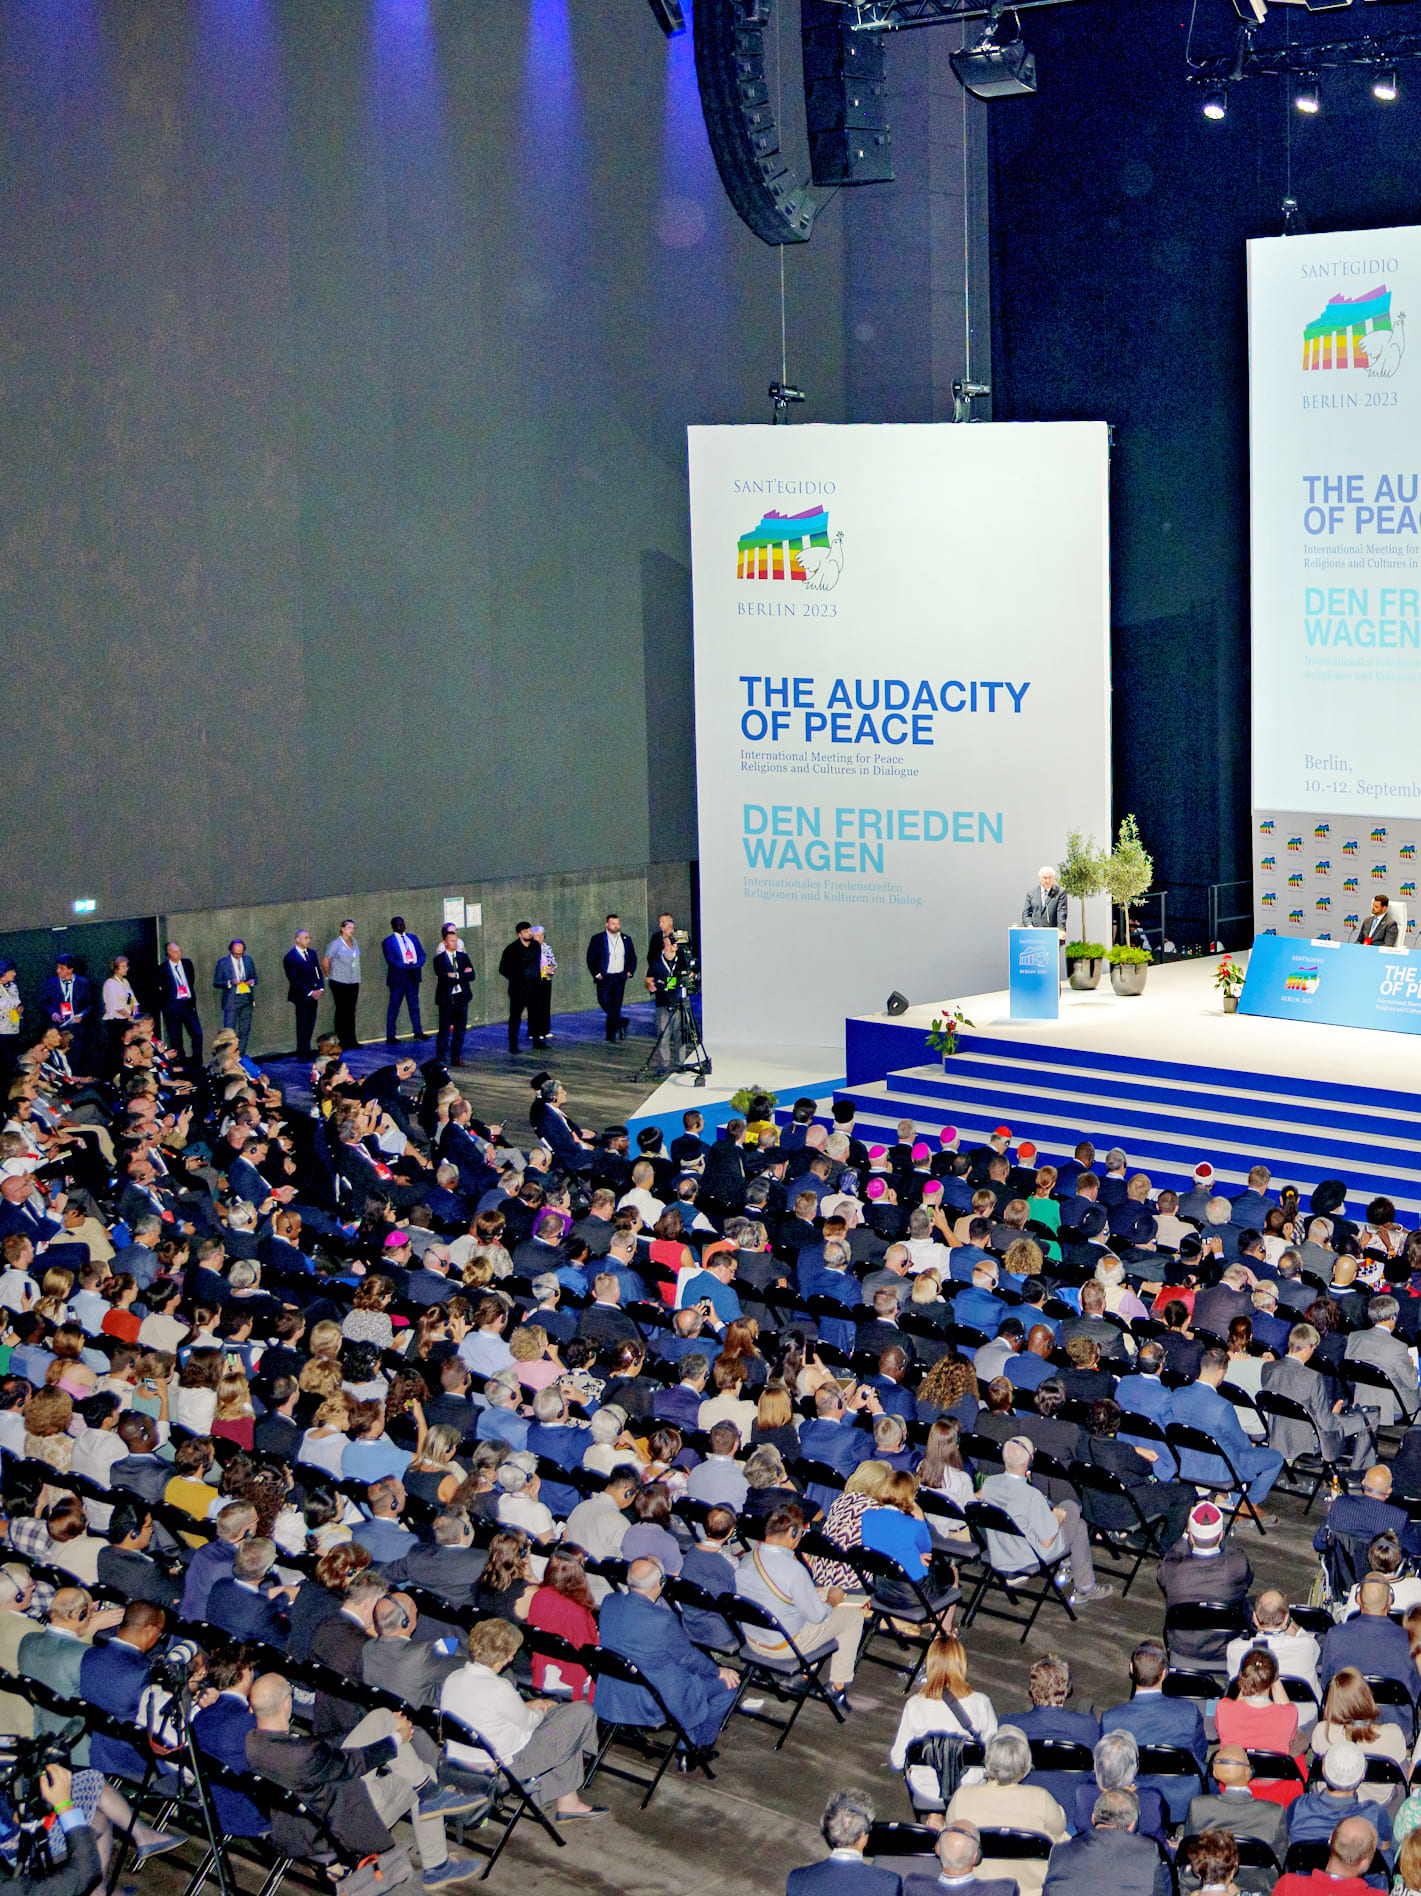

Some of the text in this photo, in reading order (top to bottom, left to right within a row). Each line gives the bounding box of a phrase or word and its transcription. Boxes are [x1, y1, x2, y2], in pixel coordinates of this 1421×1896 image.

[1301, 258, 1399, 279] SANT'EGIDIO
[1302, 392, 1399, 410] BERLIN 2023
[733, 478, 837, 495] SANT'EGIDIO
[1303, 475, 1364, 504] THE
[1303, 507, 1344, 535] OF
[1303, 544, 1363, 554] International
[1366, 544, 1404, 556] Meeting
[1406, 543, 1419, 554] for
[1303, 558, 1346, 570] Religions
[1347, 558, 1365, 568] and
[1367, 558, 1406, 569] Cultures
[1409, 558, 1418, 569] in
[737, 602, 838, 618] BERLIN 2023
[1305, 588, 1368, 616] DEN
[1303, 618, 1421, 649] WAGEN
[739, 676, 1031, 714] THE AUDACITY
[741, 710, 935, 746] OF PEACE
[740, 750, 904, 764] International Meeting for Peace
[1304, 754, 1353, 775] Berlin,
[741, 762, 919, 778] Religions and Cultures in Dialogue
[1304, 779, 1353, 796] 10.-12.
[743, 804, 1004, 844] DEN FRIEDEN
[742, 838, 884, 873] WAGEN
[1385, 965, 1418, 982] THE
[1380, 980, 1404, 996] OF
